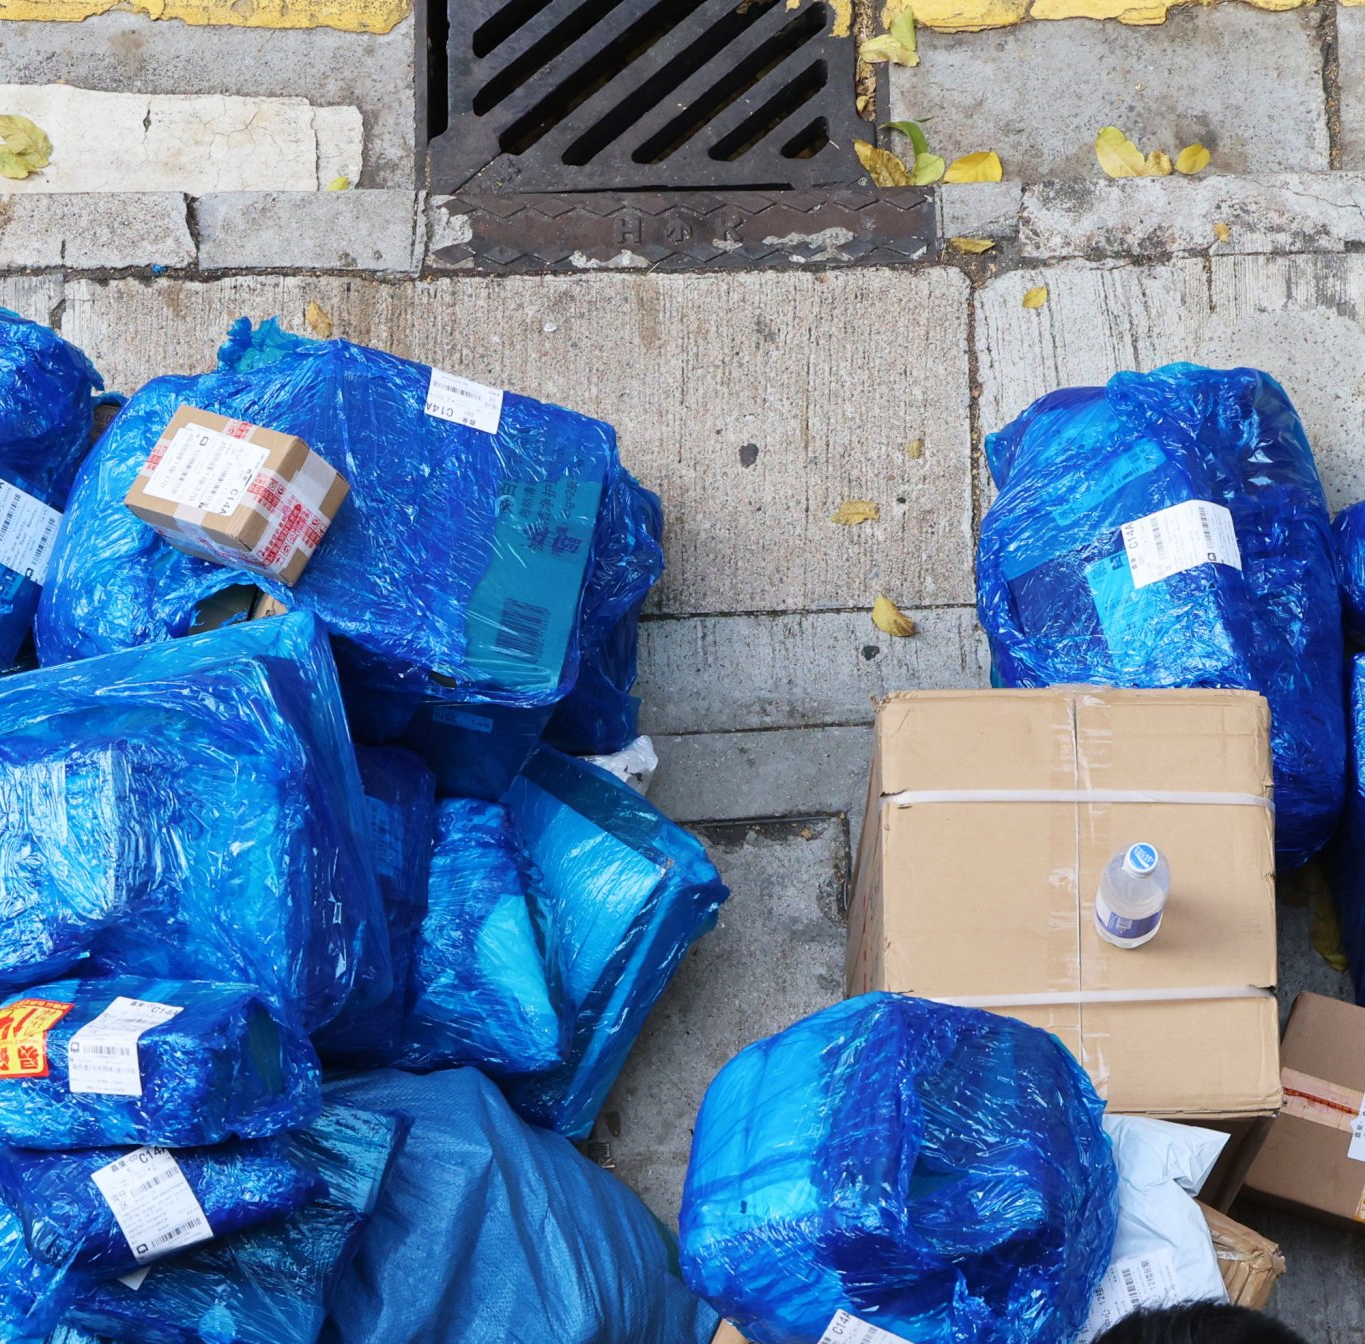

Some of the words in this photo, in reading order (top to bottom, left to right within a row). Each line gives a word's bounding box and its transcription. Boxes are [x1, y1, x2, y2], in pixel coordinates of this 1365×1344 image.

[424, 401, 454, 417] C14A
[1126, 523, 1137, 551] C14A
[831, 1309, 852, 1335] C14A
